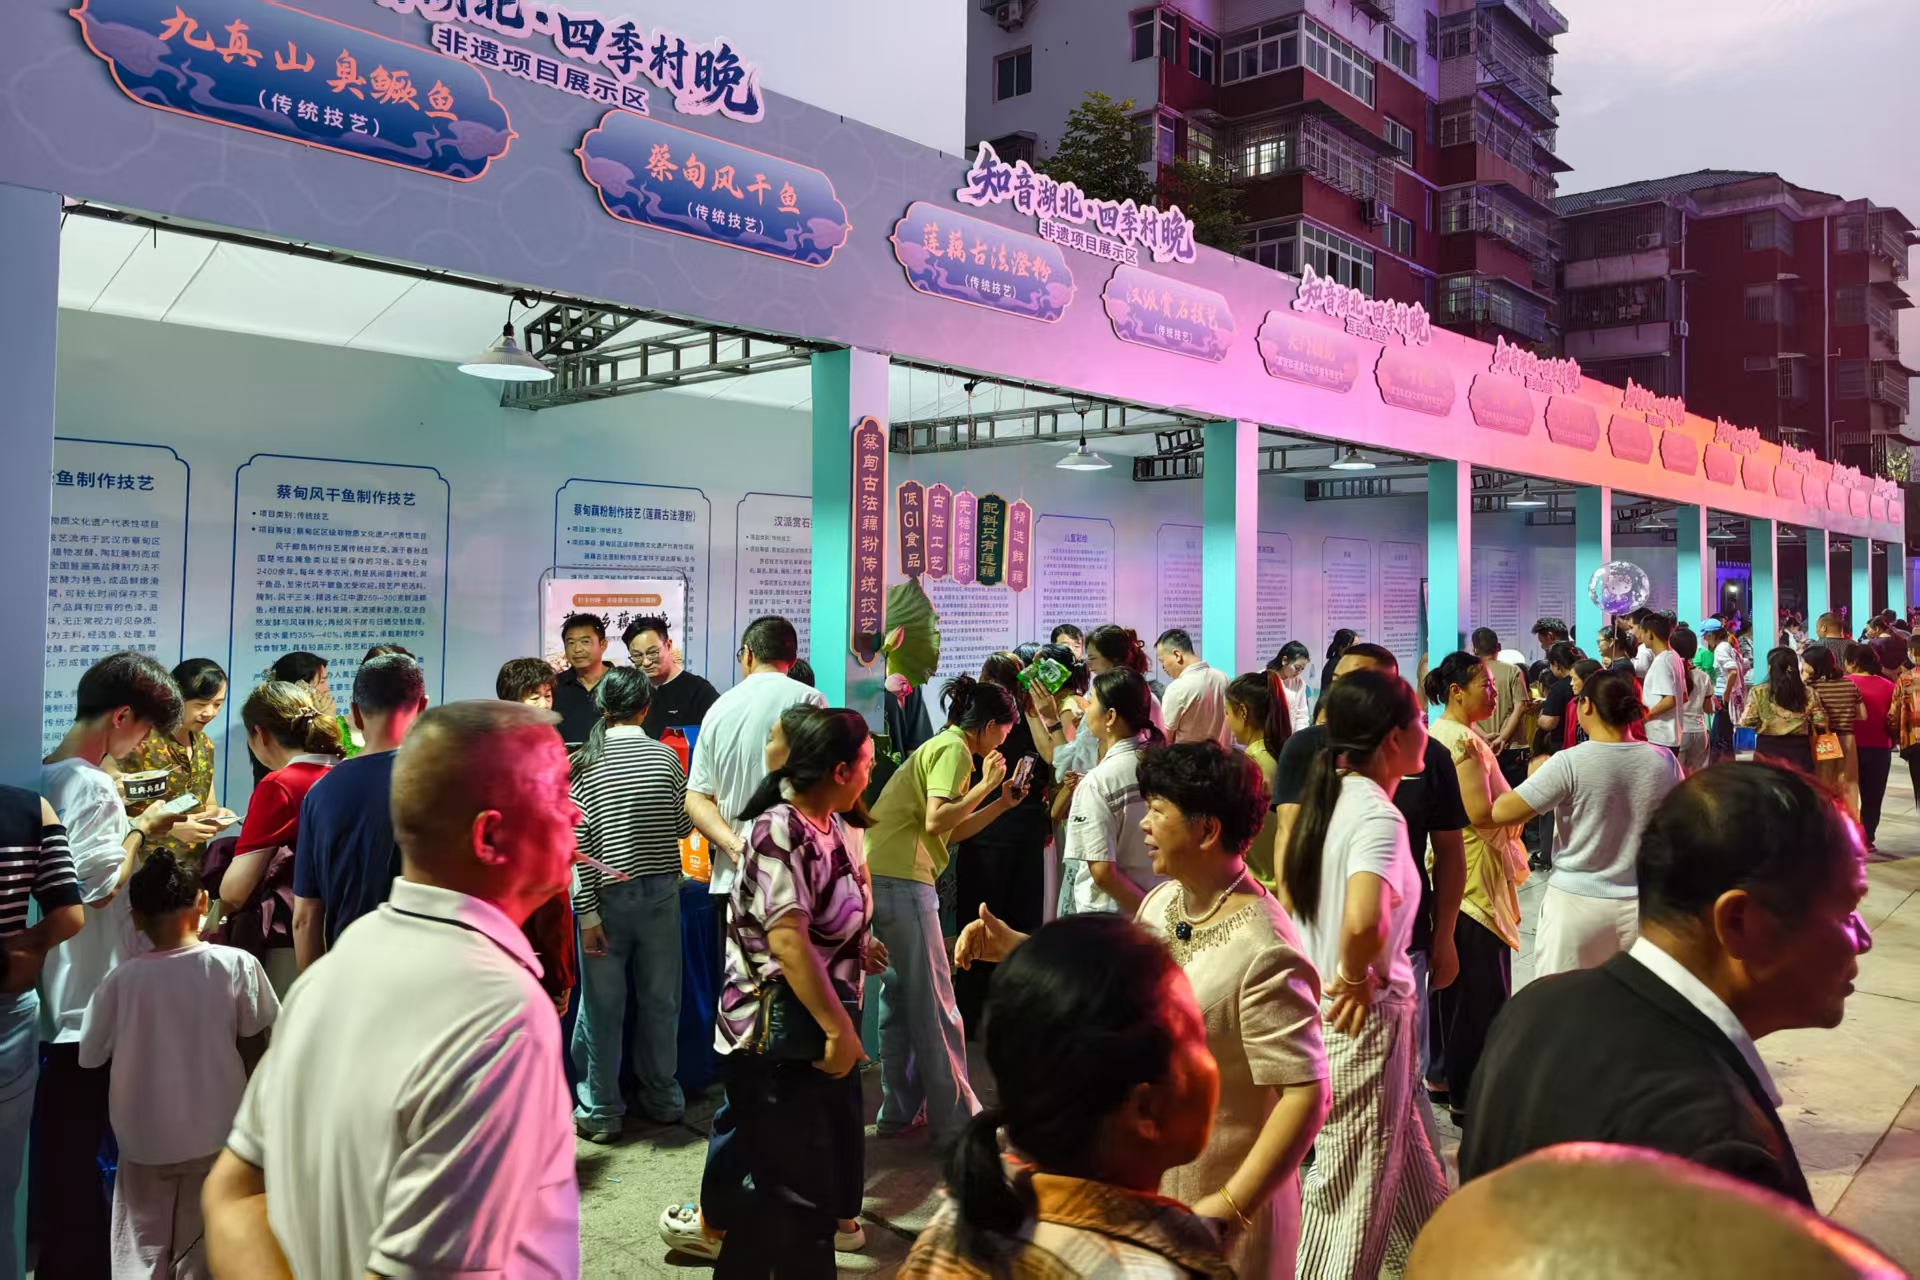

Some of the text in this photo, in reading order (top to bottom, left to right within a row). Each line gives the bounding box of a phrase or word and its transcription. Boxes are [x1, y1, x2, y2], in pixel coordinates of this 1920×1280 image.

[158, 6, 458, 121] 九真山臭鳜鱼
[436, 27, 648, 113] 非遗项目展示区
[258, 89, 380, 138] （传统技艺）
[644, 143, 801, 215] 蔡甸风干鱼
[971, 147, 1194, 260] 知音湖北·四季村晚
[687, 201, 764, 236] （传统技艺）
[1041, 222, 1138, 264] 非遗项目展示区
[922, 219, 1052, 284] 莲藕古法澄粉
[964, 273, 1017, 299] （传统技艺）
[1154, 322, 1193, 343] （传统技艺）
[1347, 318, 1389, 342] 互动体验区
[52, 469, 155, 491] 鱼制作技艺
[276, 483, 417, 507] 蔡甸风干鱼制作技艺
[774, 515, 813, 528] 汉派赏石
[860, 432, 880, 635] 蔡甸古法藕粉传统技艺
[929, 494, 946, 571] 古法工艺
[980, 502, 1000, 578] 配料只有莲藕
